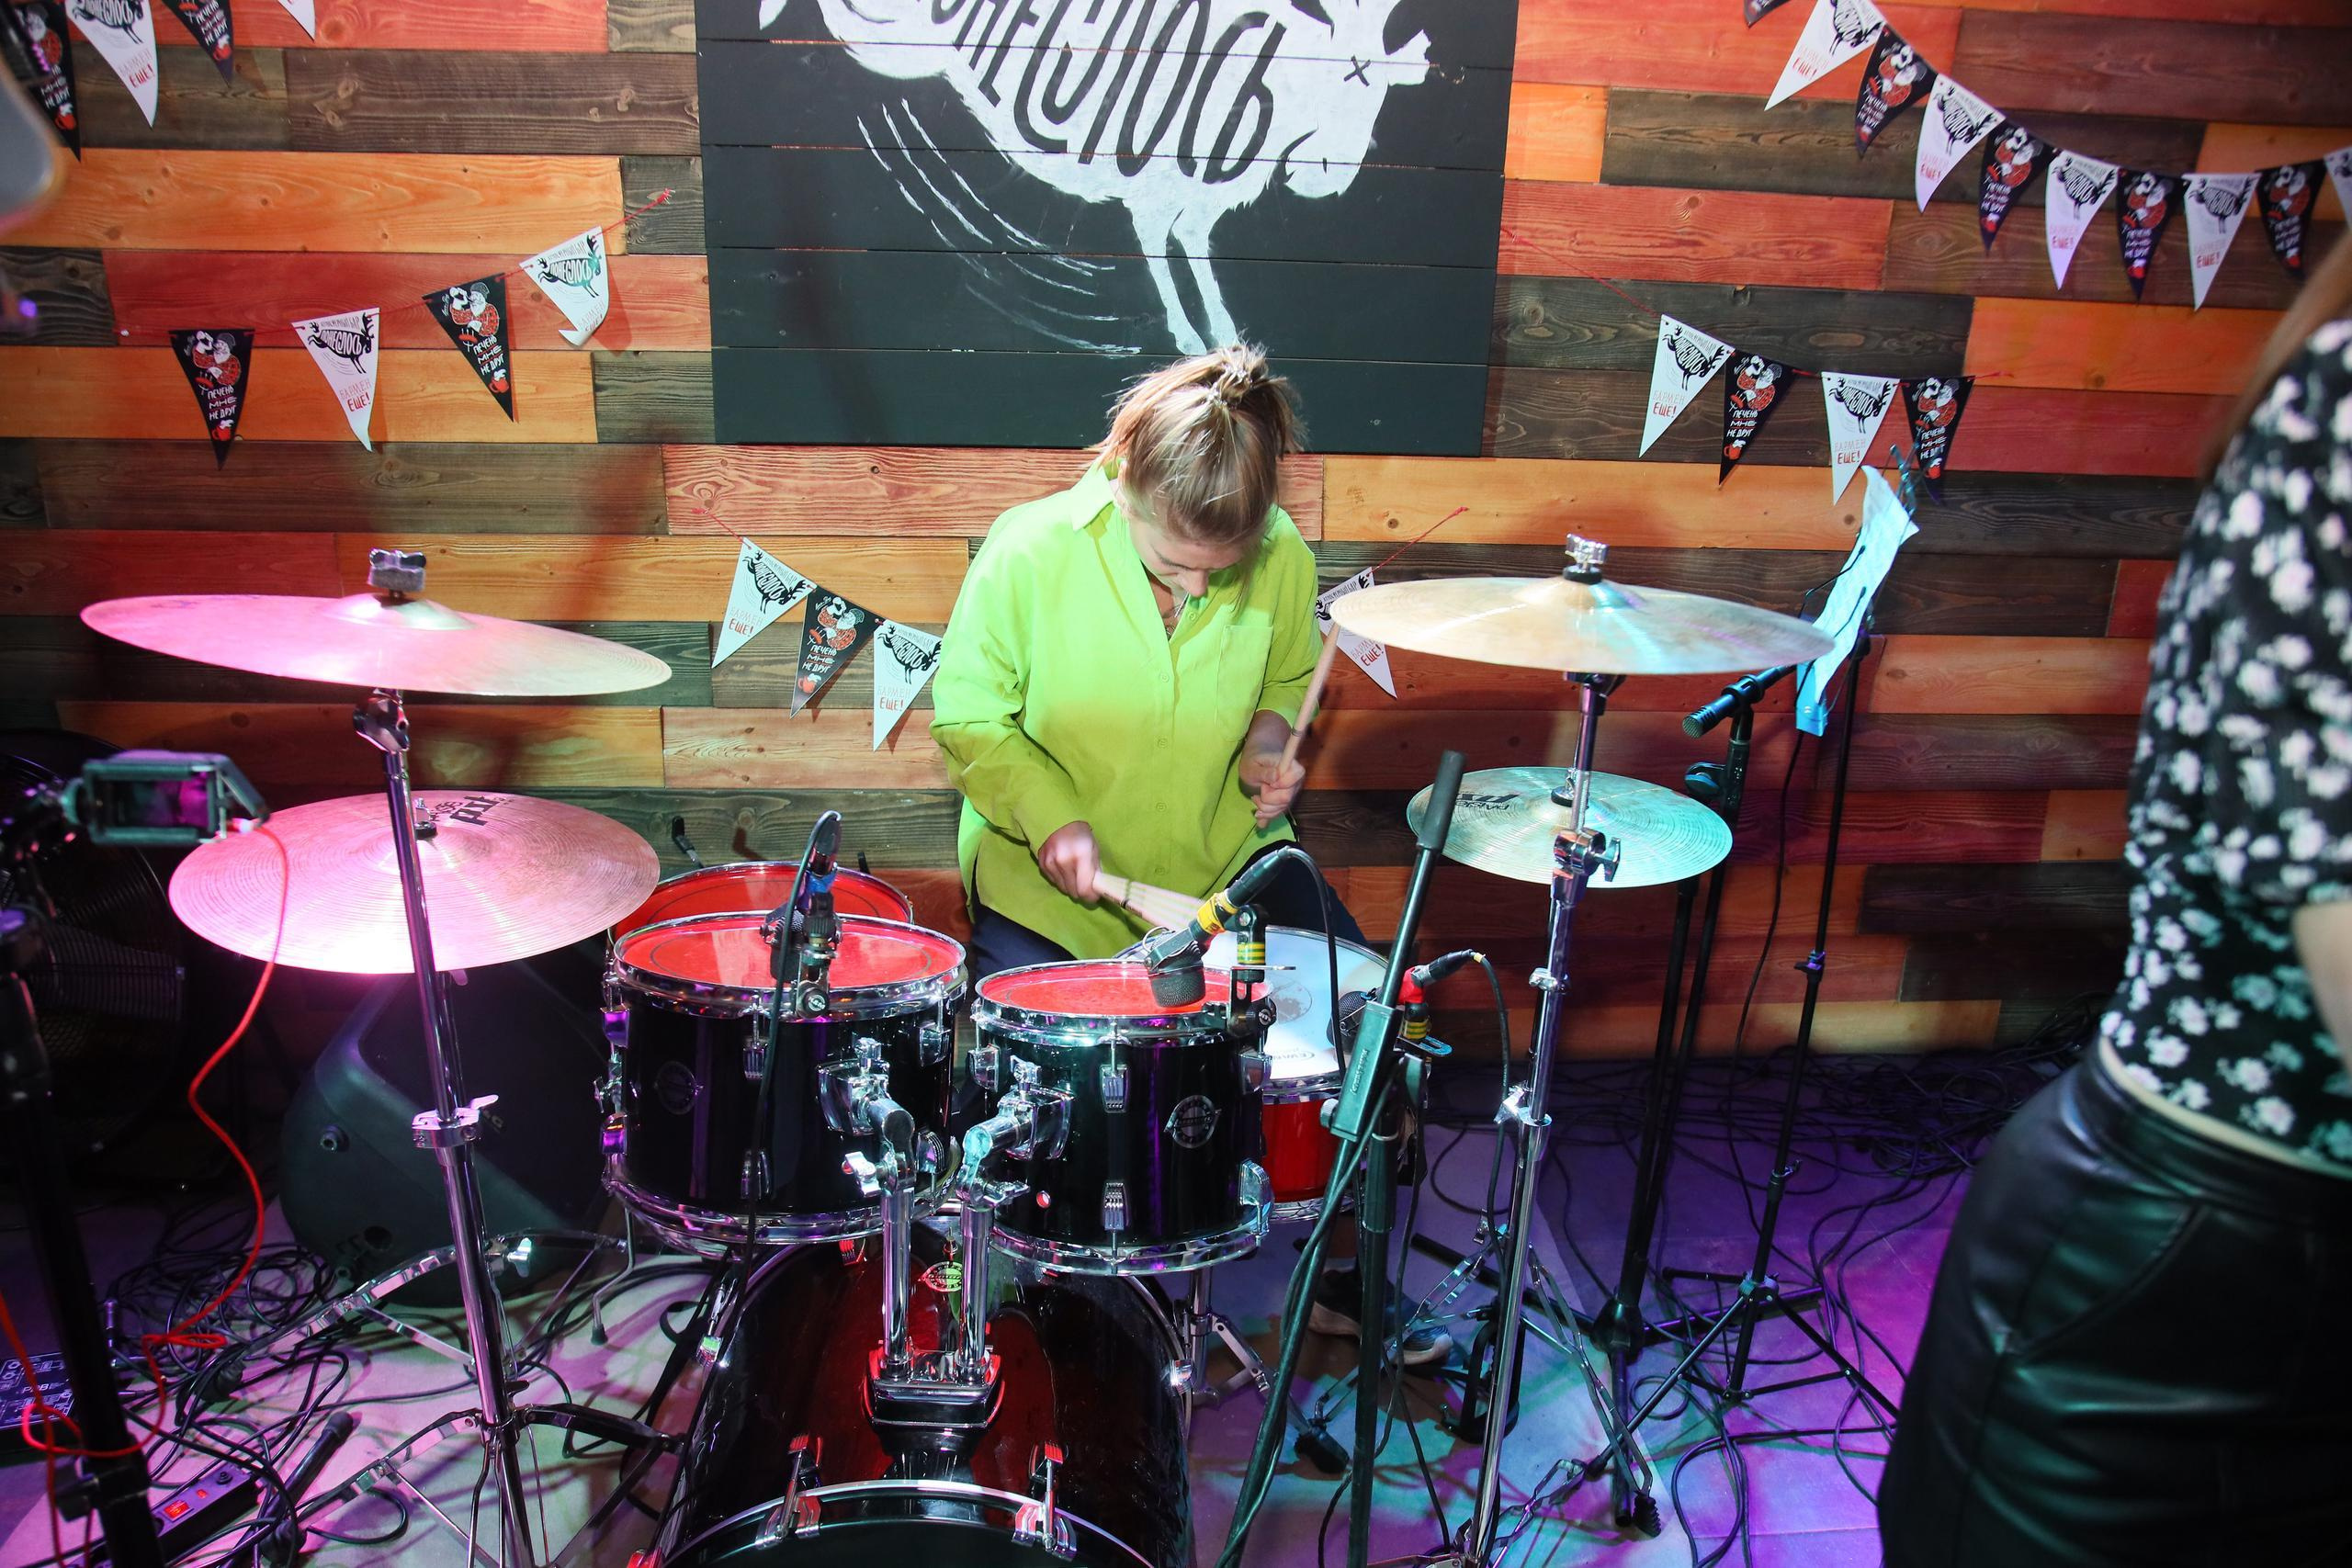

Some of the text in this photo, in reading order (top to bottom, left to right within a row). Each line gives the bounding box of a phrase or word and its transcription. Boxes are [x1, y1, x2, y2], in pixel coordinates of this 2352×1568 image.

[931, 0, 1286, 184] ЕСЛОСЬ
[473, 334, 498, 355] ПЕЧЕНЬ
[478, 344, 502, 365] МНЕ
[481, 365, 491, 376] НЕ
[346, 391, 371, 412] ЕЩЕ!
[1654, 402, 1677, 419] ЕЩЕ!
[1733, 410, 1758, 418] ПЕЧЕНЬ
[1726, 428, 1736, 437] НЕ
[1838, 450, 1860, 465] ЕЩЕ!
[728, 618, 754, 637] ЕЩЕ!
[810, 643, 838, 656] ПЕЧЕНЬ
[1360, 645, 1385, 667] ЕЩЕ!
[808, 654, 836, 664] МНЕ
[802, 661, 831, 673] НЕ ДРУГ
[879, 697, 904, 712] ЕЩЕ!
